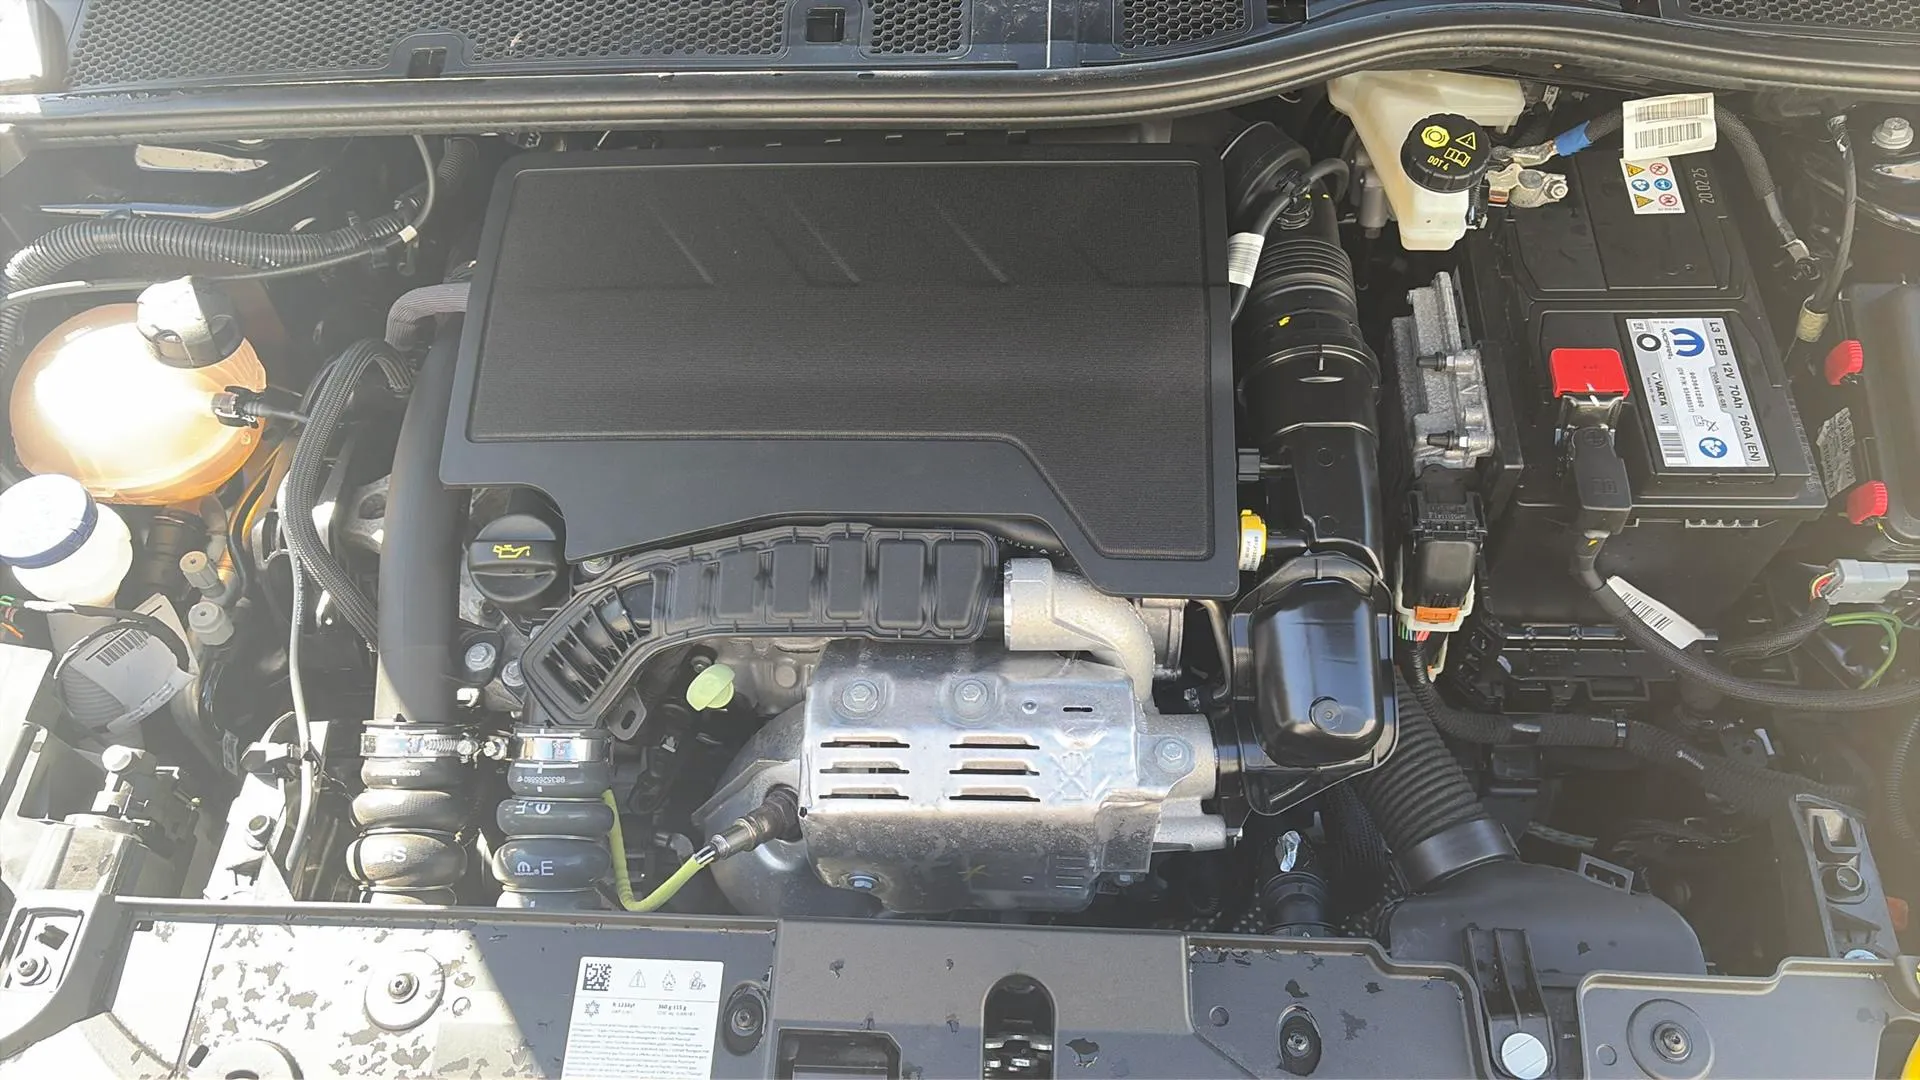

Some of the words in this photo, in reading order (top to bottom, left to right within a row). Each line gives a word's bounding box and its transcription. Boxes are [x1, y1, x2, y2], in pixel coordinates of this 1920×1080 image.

[1427, 155, 1444, 167] DOT
[1442, 163, 1450, 171] 4
[1709, 321, 1721, 333] L3
[1714, 338, 1728, 356] EFB
[1721, 362, 1736, 379] 12V
[1654, 380, 1667, 406] VARTA
[1729, 384, 1743, 409] 70Ah
[1738, 414, 1753, 440] 760A
[1745, 442, 1761, 462] (EN)
[541, 860, 554, 876] E
